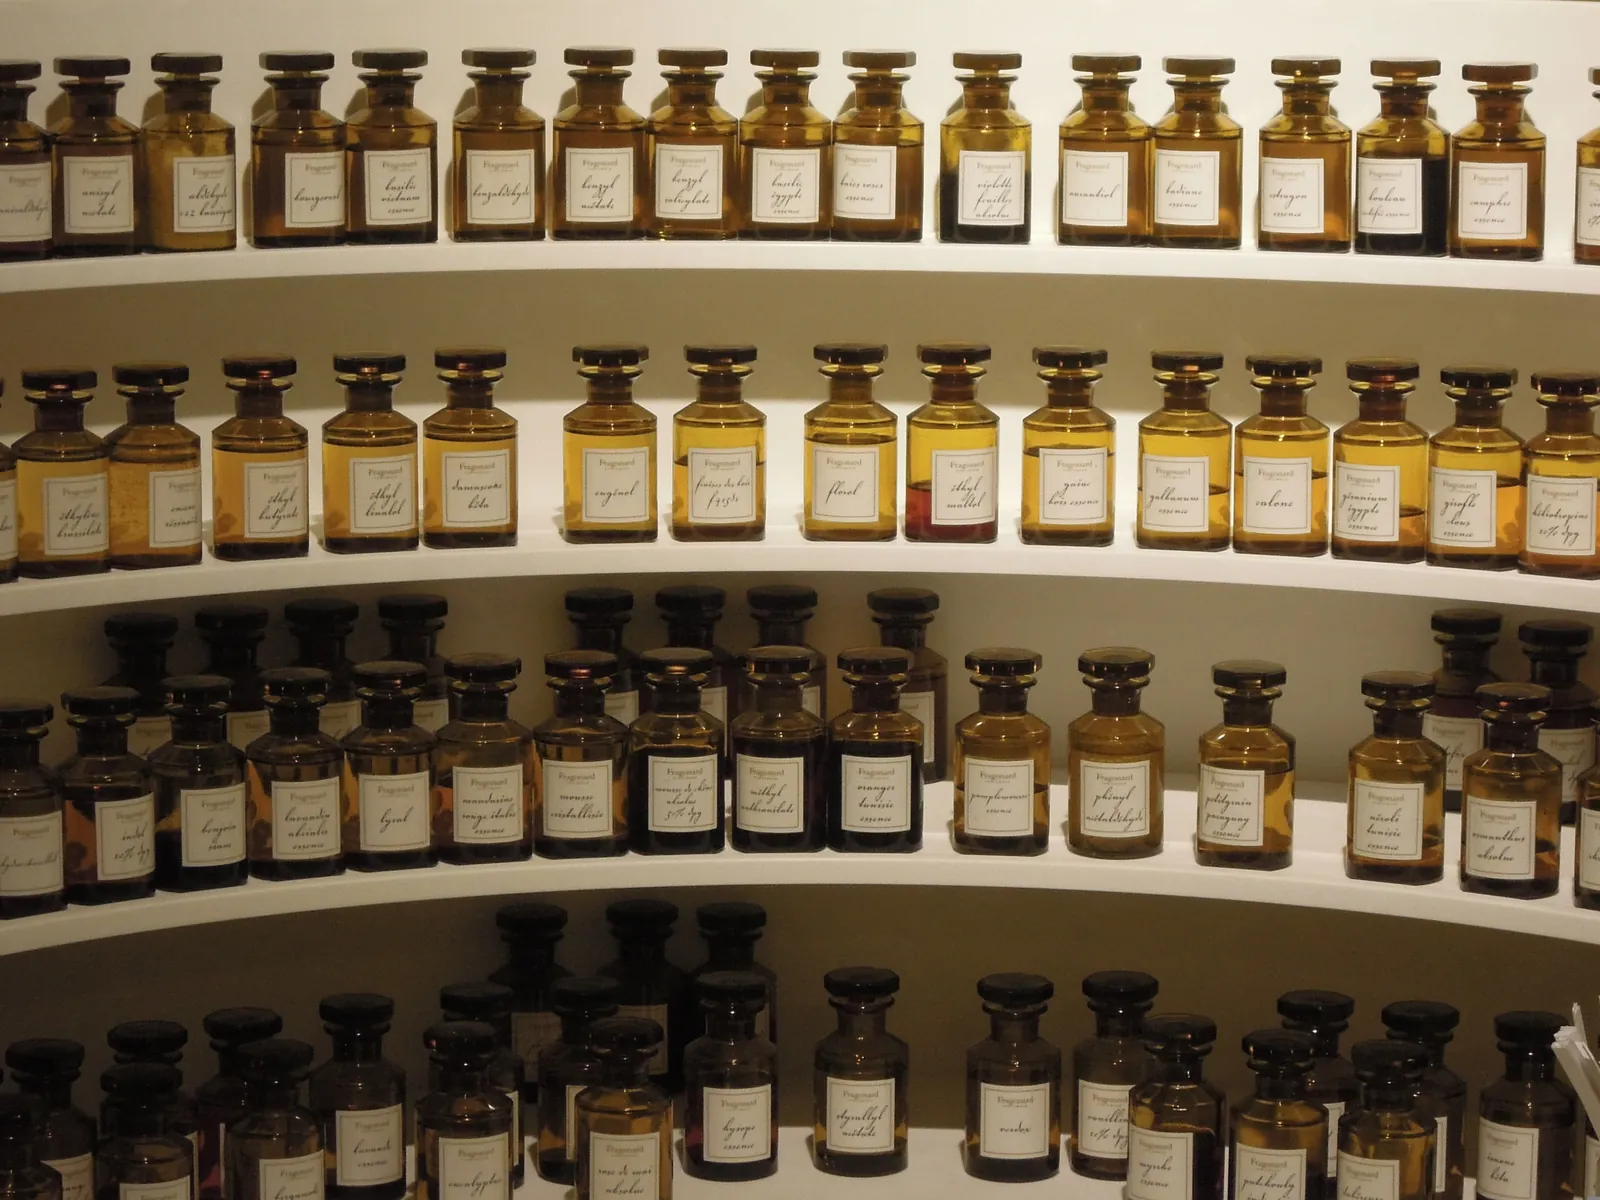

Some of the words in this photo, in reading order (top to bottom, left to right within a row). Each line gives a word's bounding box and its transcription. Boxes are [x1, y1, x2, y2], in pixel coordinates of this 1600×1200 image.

[583, 159, 618, 168] Fragonard
[671, 156, 706, 165] Fragonard
[770, 159, 804, 168] Fragonard
[673, 170, 709, 191] benzyl
[582, 175, 620, 198] benzyl
[460, 462, 494, 471] Fragonard
[599, 458, 635, 467] Fragonard
[705, 458, 740, 467] Fragonard
[827, 457, 862, 467] Fragonard
[950, 460, 984, 469] Fragonard
[1156, 467, 1190, 476] Fragonard
[1258, 468, 1294, 477] Fragonard
[1347, 474, 1380, 484] Fragonard
[1443, 480, 1477, 489] Fragonard
[559, 772, 595, 781] Fragonard
[667, 768, 703, 777] Fragonard
[750, 767, 784, 777] Fragonard
[859, 768, 895, 777] Fragonard
[980, 771, 1016, 781] Fragonard
[1096, 773, 1133, 782] Fragonard
[471, 778, 507, 787] Fragonard
[379, 785, 414, 794] Fragonard
[1368, 791, 1404, 802] Fragonard
[844, 1090, 878, 1099] Fragonard
[997, 1096, 1033, 1105] Fragonard
